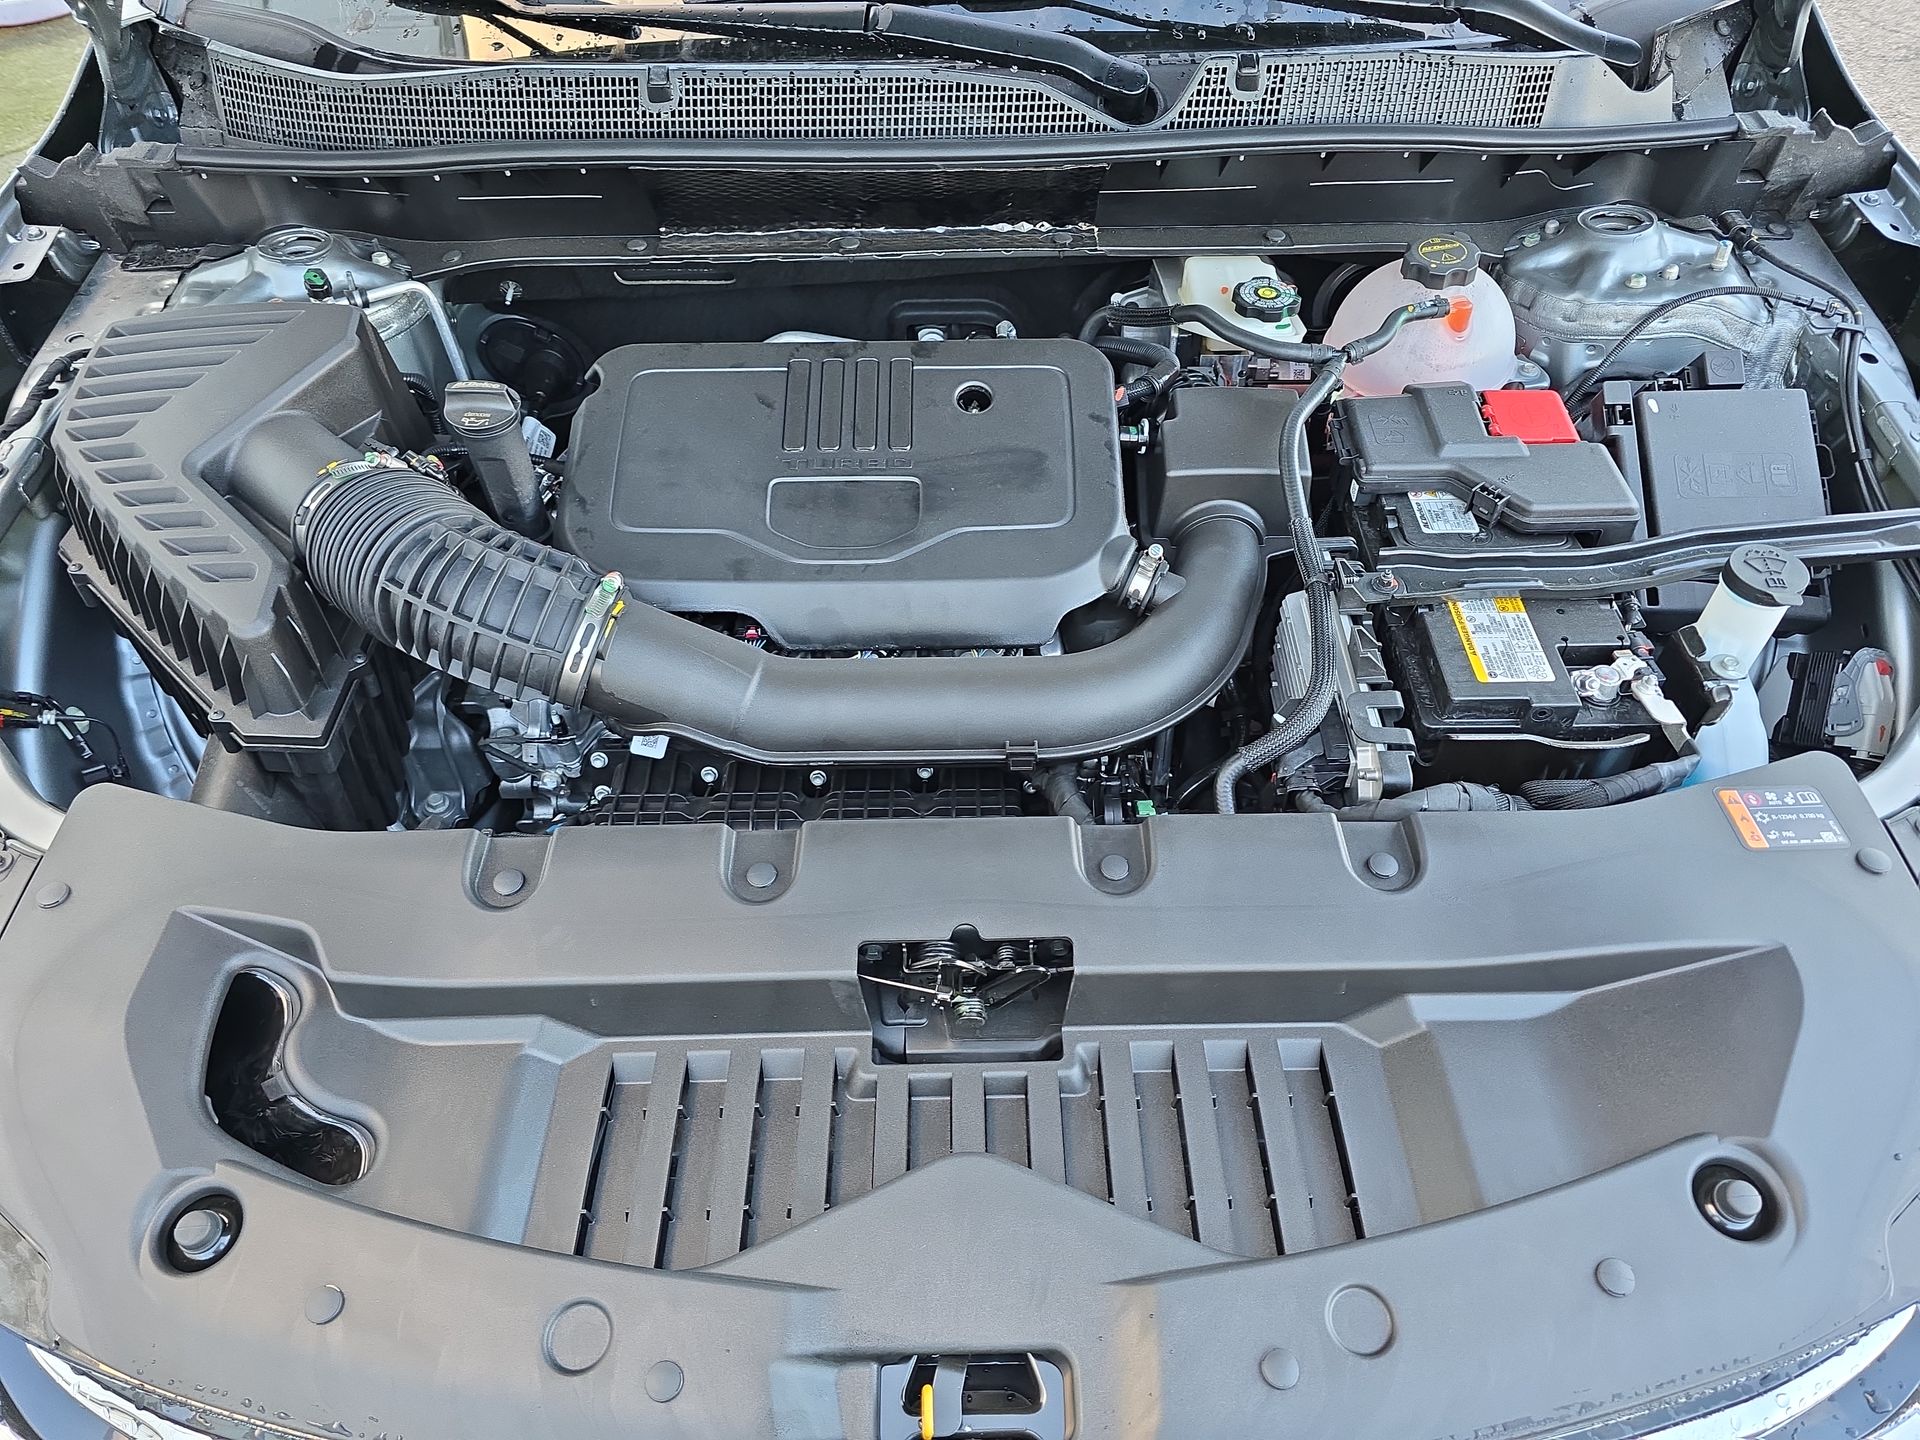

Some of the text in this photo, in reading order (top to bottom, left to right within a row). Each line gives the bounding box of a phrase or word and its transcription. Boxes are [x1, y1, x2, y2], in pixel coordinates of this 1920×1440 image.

[1421, 242, 1460, 253] ACDelco
[451, 381, 501, 389] ACDelco
[782, 458, 913, 470] TURBO
[1415, 502, 1430, 529] ACDelco
